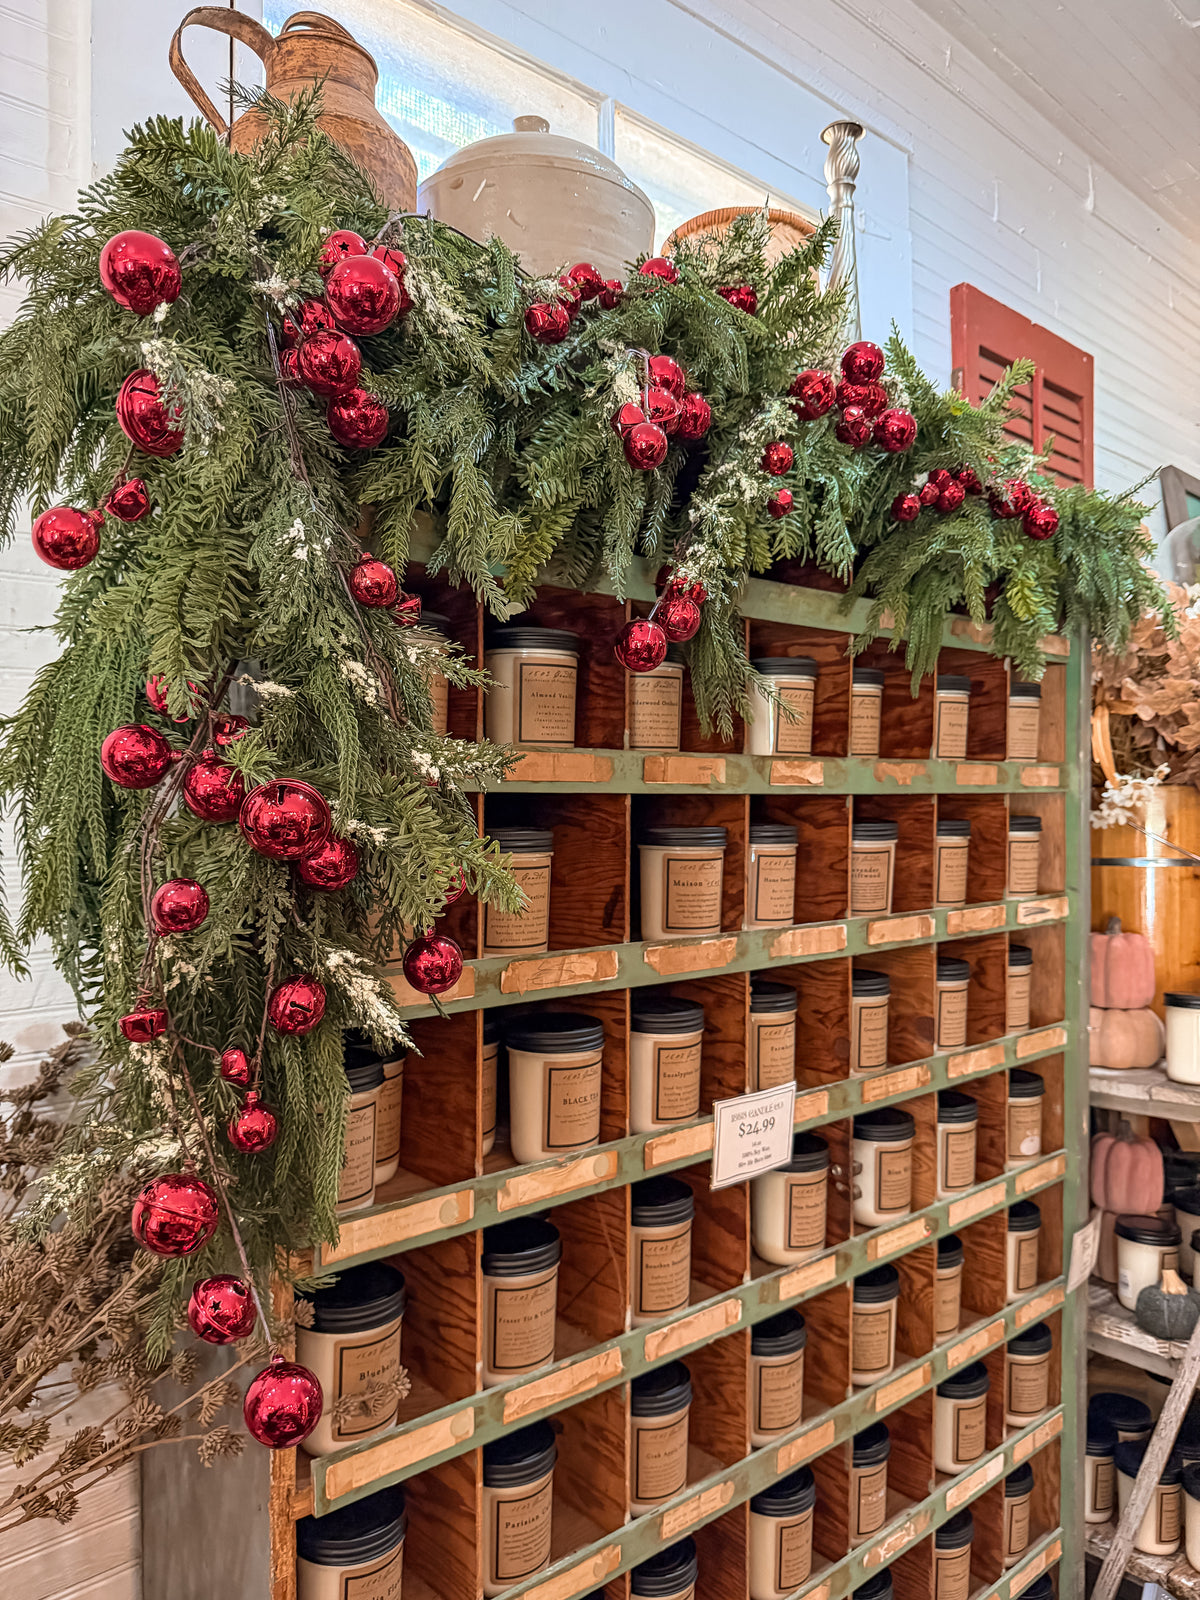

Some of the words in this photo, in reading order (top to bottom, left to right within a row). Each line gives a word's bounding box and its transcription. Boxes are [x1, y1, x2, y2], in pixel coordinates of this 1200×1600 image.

[673, 879, 703, 887] Maison
[563, 1096, 587, 1106] BLACK
[738, 1116, 775, 1138] $24.99
[505, 1515, 540, 1529] Parisian
